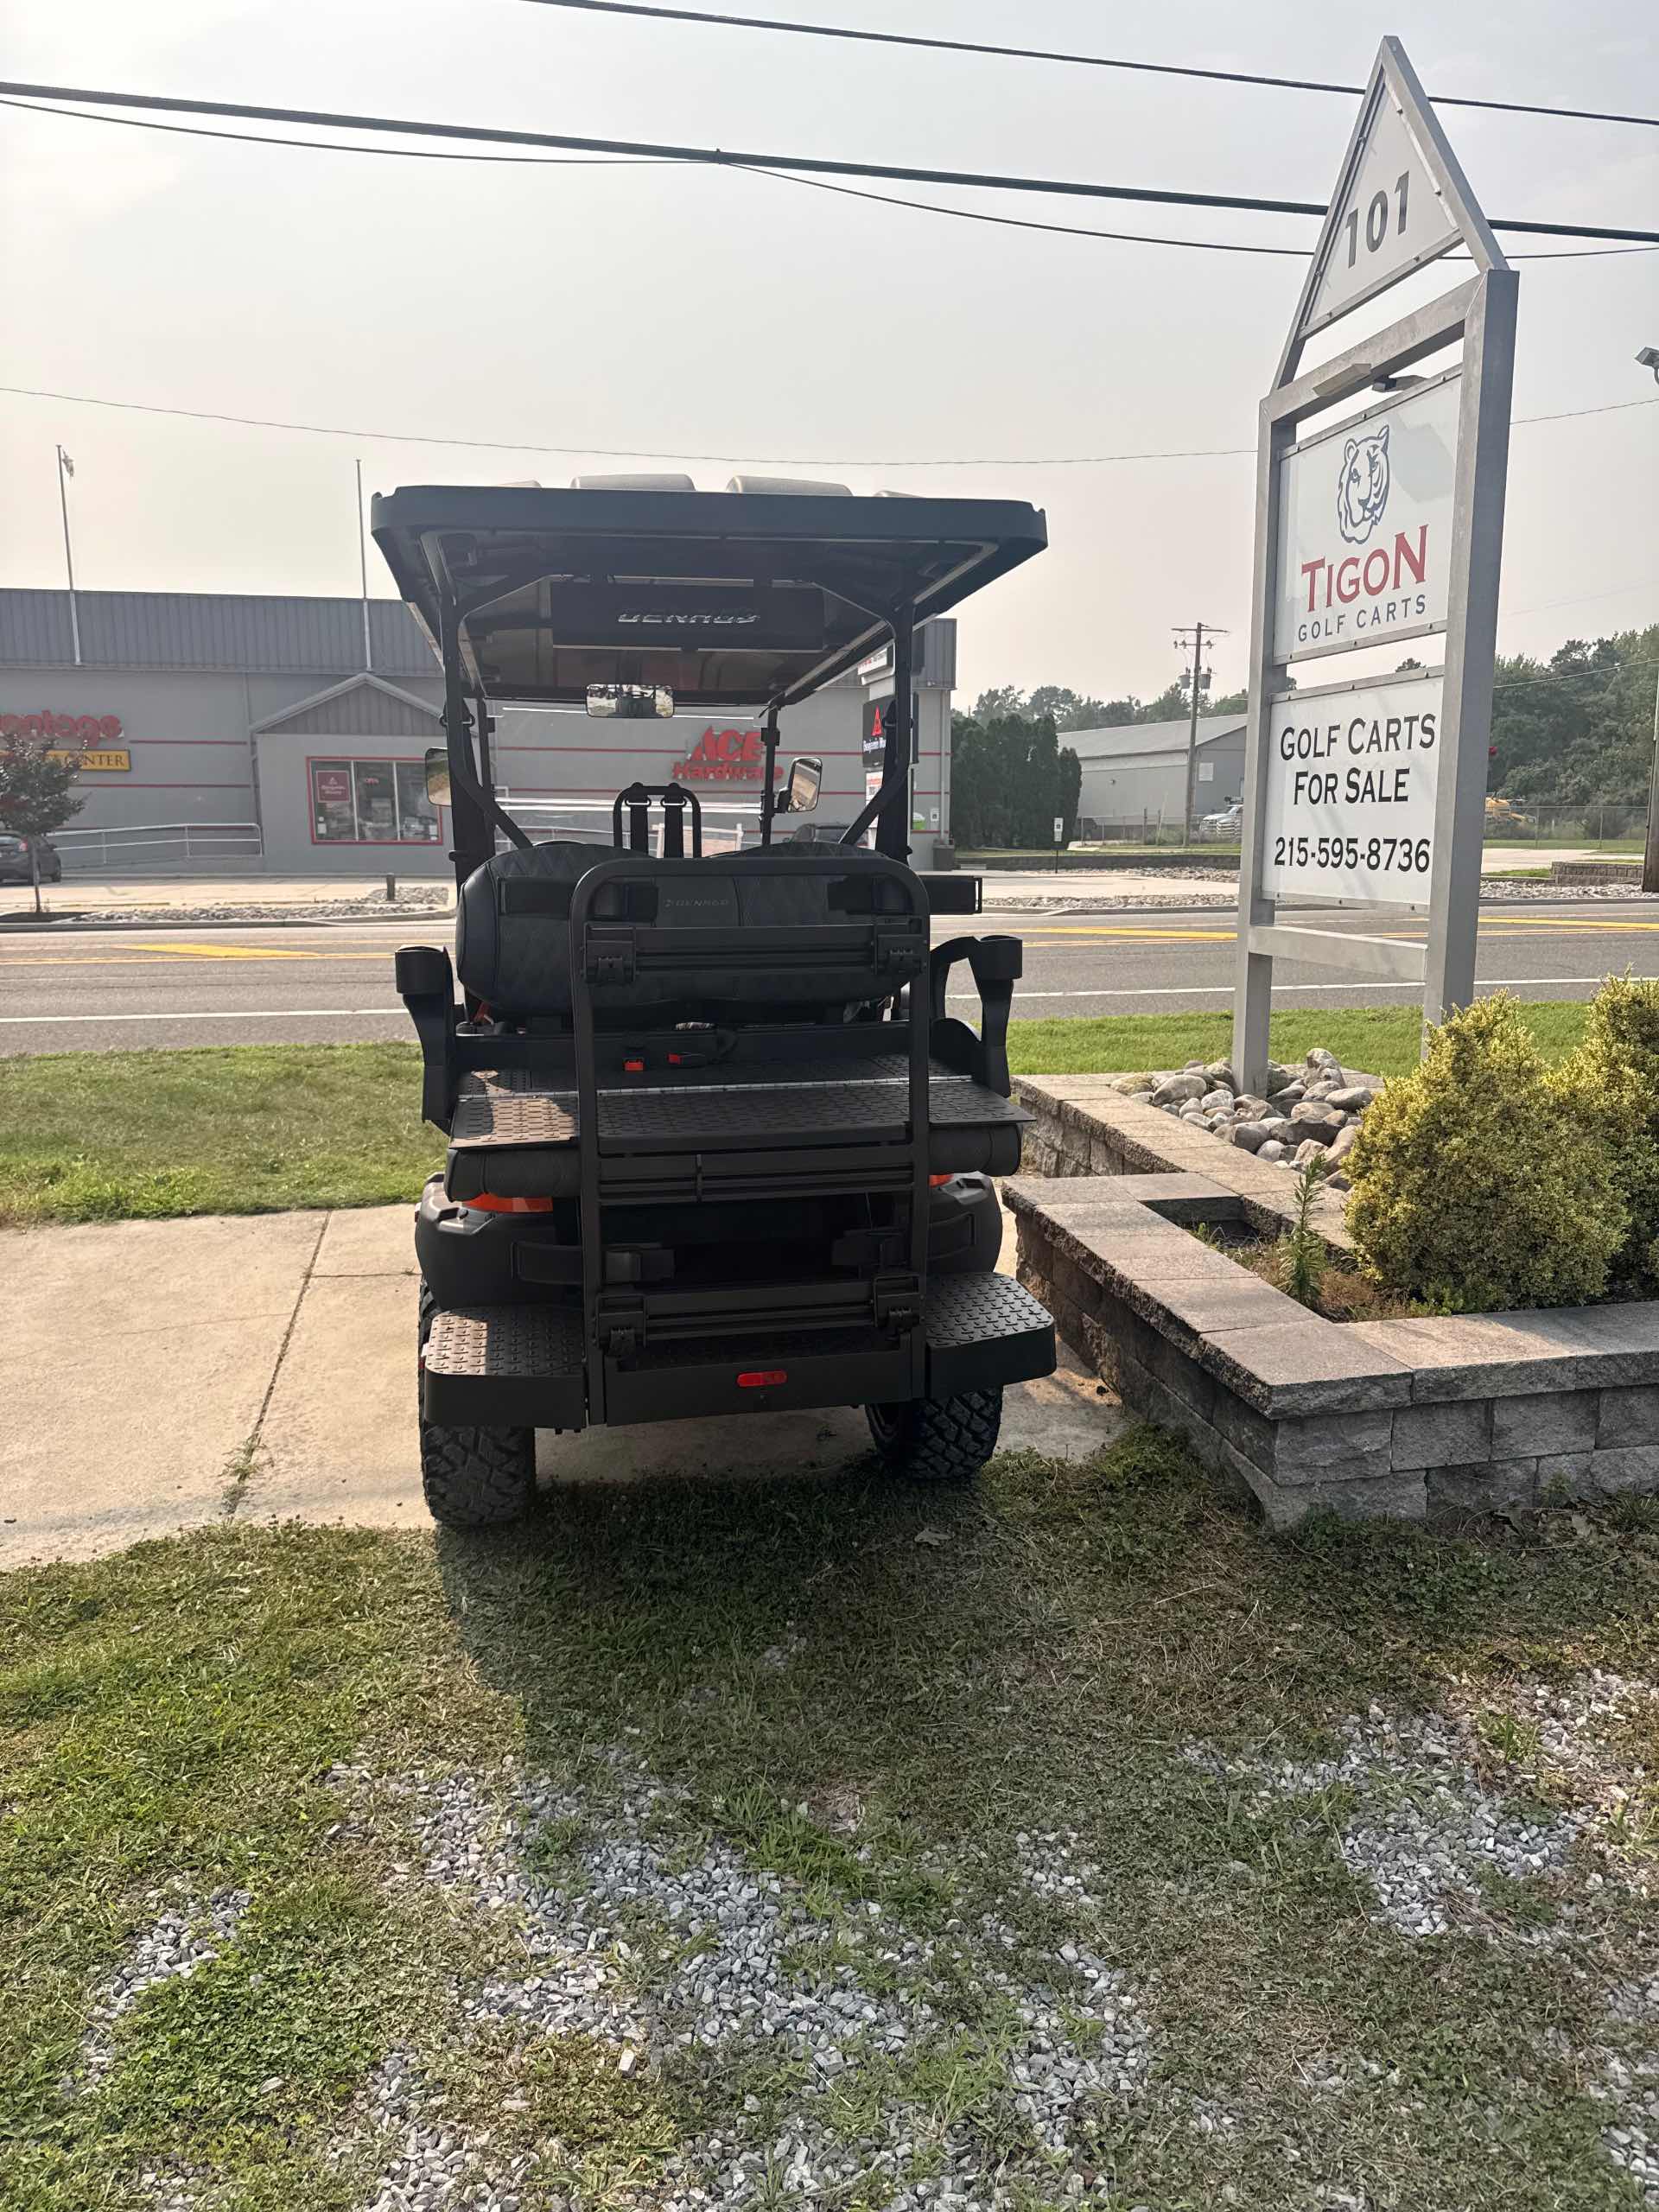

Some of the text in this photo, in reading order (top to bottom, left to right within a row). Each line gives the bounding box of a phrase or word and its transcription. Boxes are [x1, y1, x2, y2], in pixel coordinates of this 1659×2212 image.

[1344, 170, 1409, 269] 101
[1301, 524, 1429, 613] TIGON
[1298, 594, 1426, 642] GOLF CARTS
[690, 725, 764, 761] ACE
[1280, 714, 1436, 761] GOLF CARTS
[1294, 766, 1410, 805] FOR SALE
[1274, 836, 1431, 873] 215-595-8736
